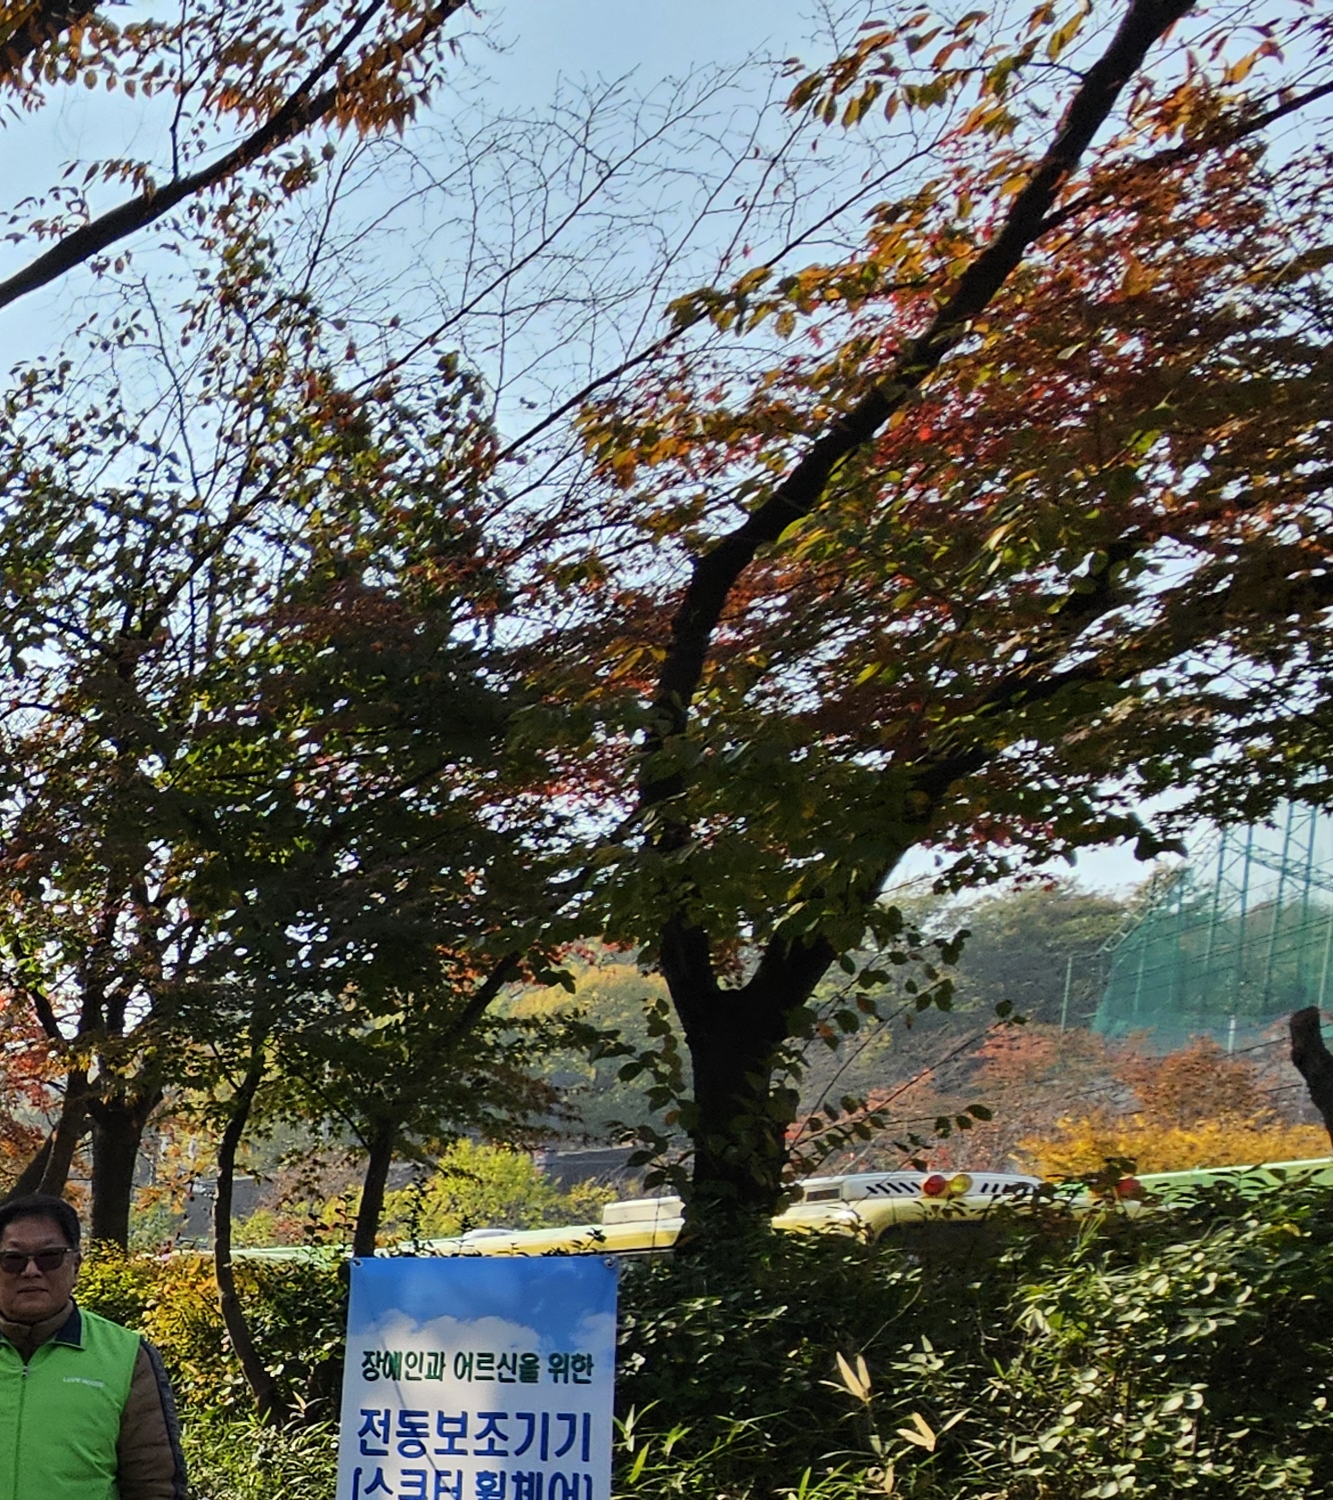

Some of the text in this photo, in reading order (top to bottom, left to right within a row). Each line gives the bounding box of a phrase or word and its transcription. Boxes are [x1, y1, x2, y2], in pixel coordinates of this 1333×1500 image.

[361, 1350, 594, 1384] 장애인과 어르신을 위한
[357, 1408, 591, 1462] 전동보조기기
